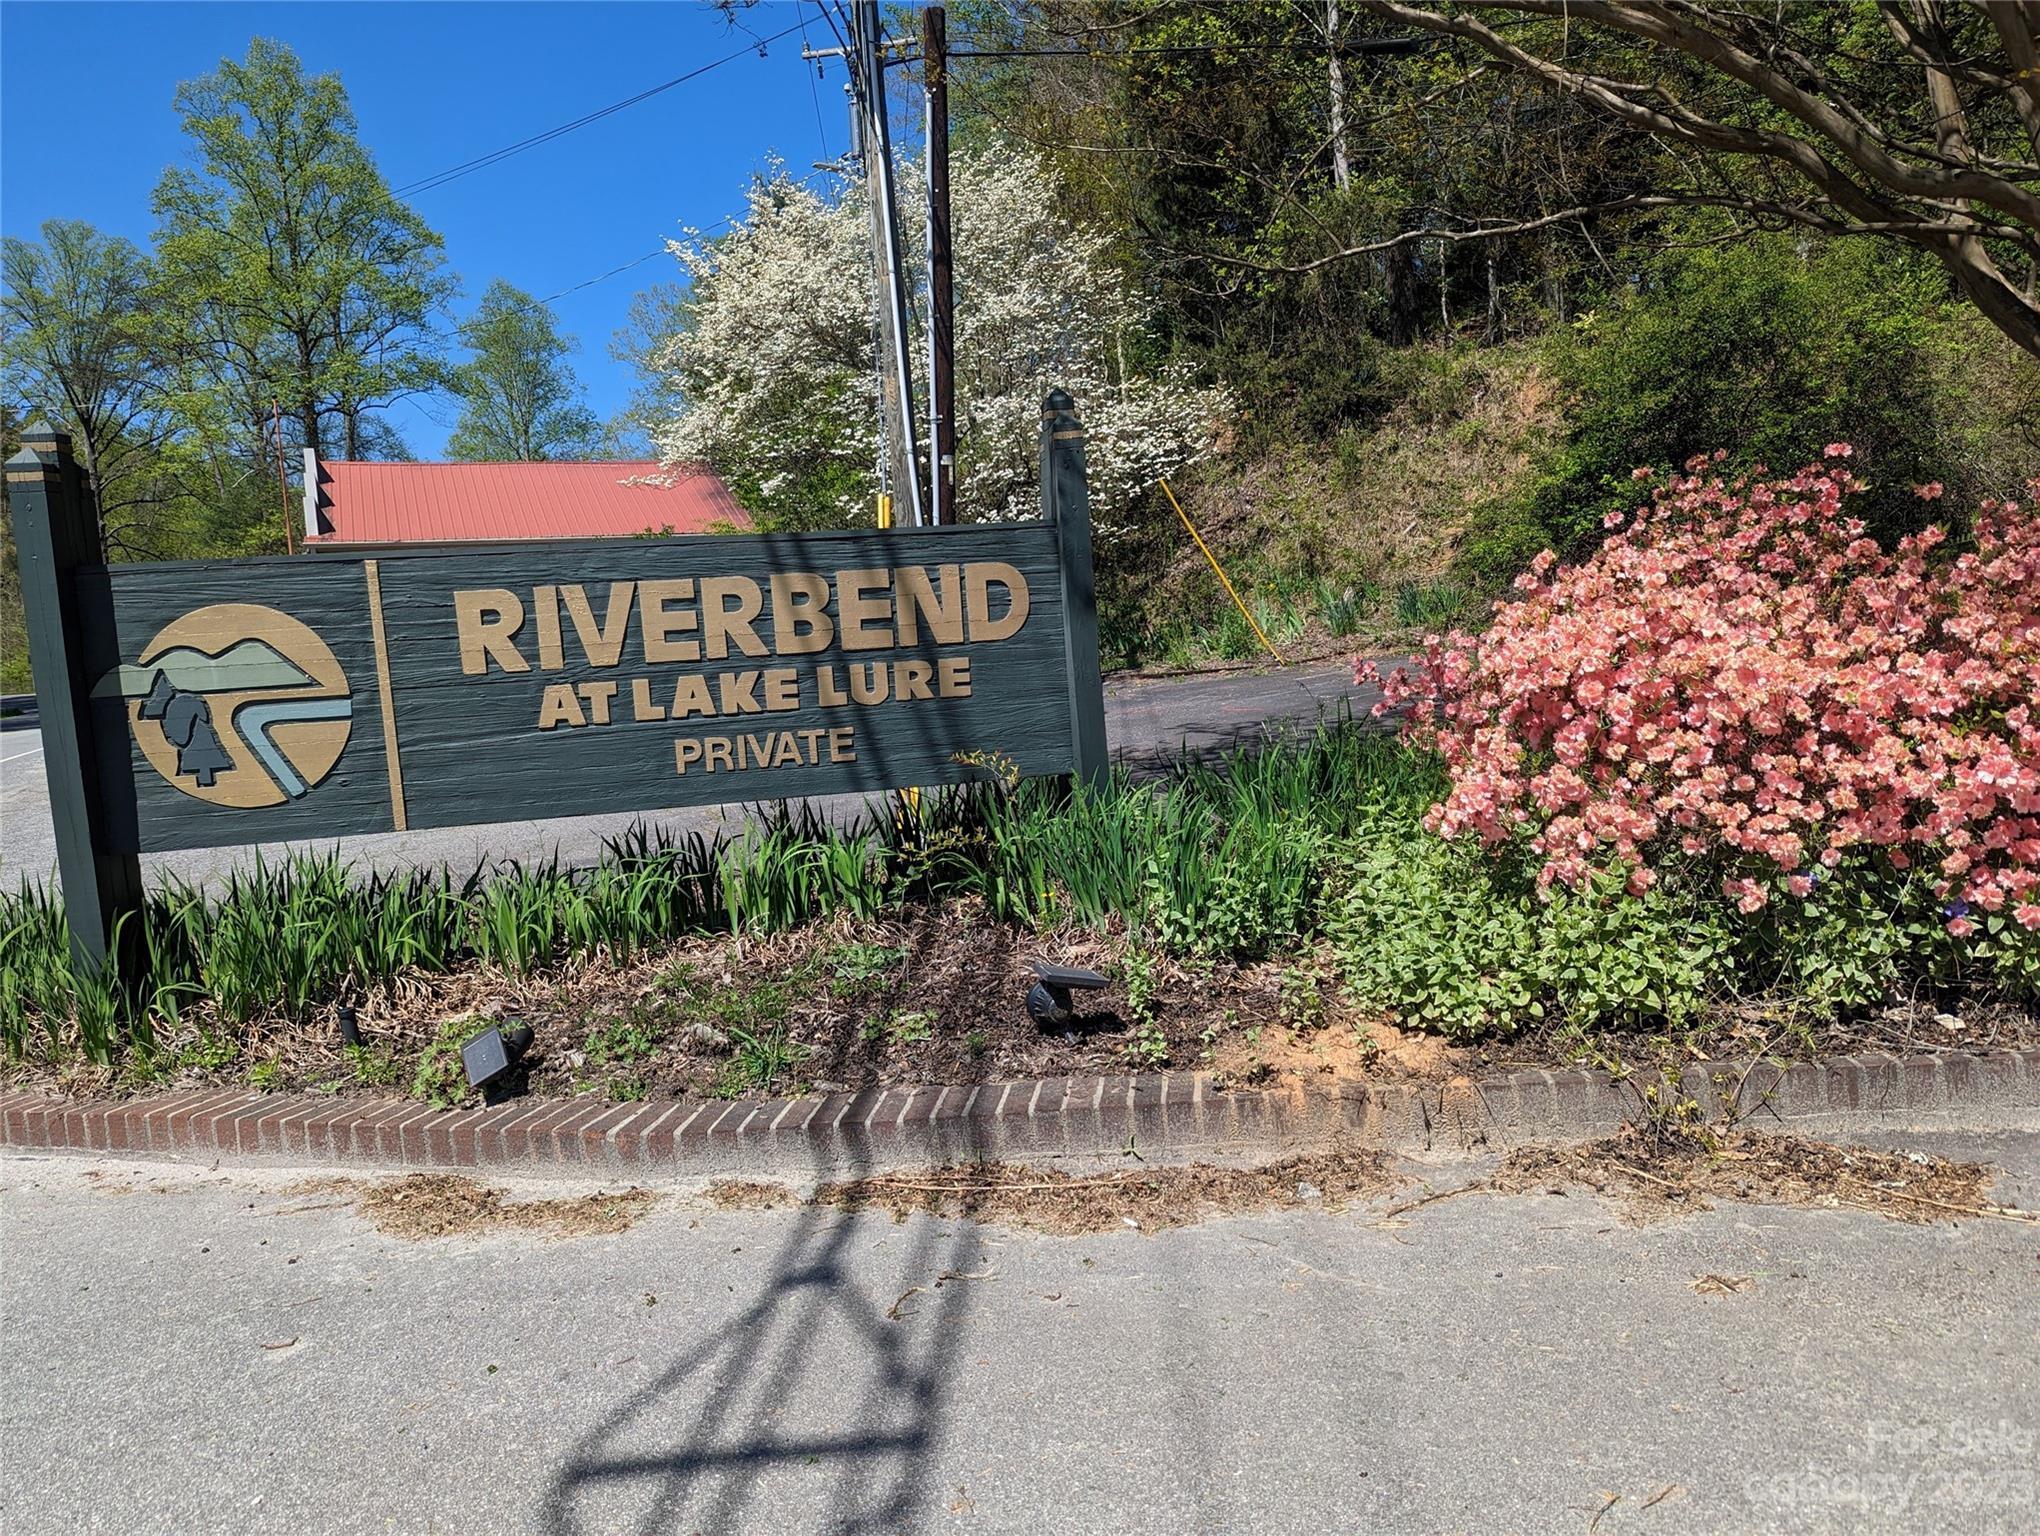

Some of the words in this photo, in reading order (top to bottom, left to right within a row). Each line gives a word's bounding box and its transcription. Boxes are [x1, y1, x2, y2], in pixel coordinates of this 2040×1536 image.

[453, 562, 1031, 676] RIVERBEND
[538, 681, 618, 729] AT
[632, 669, 801, 722] LAKE
[816, 656, 973, 708] LURE
[674, 726, 857, 775] PRIVATE
